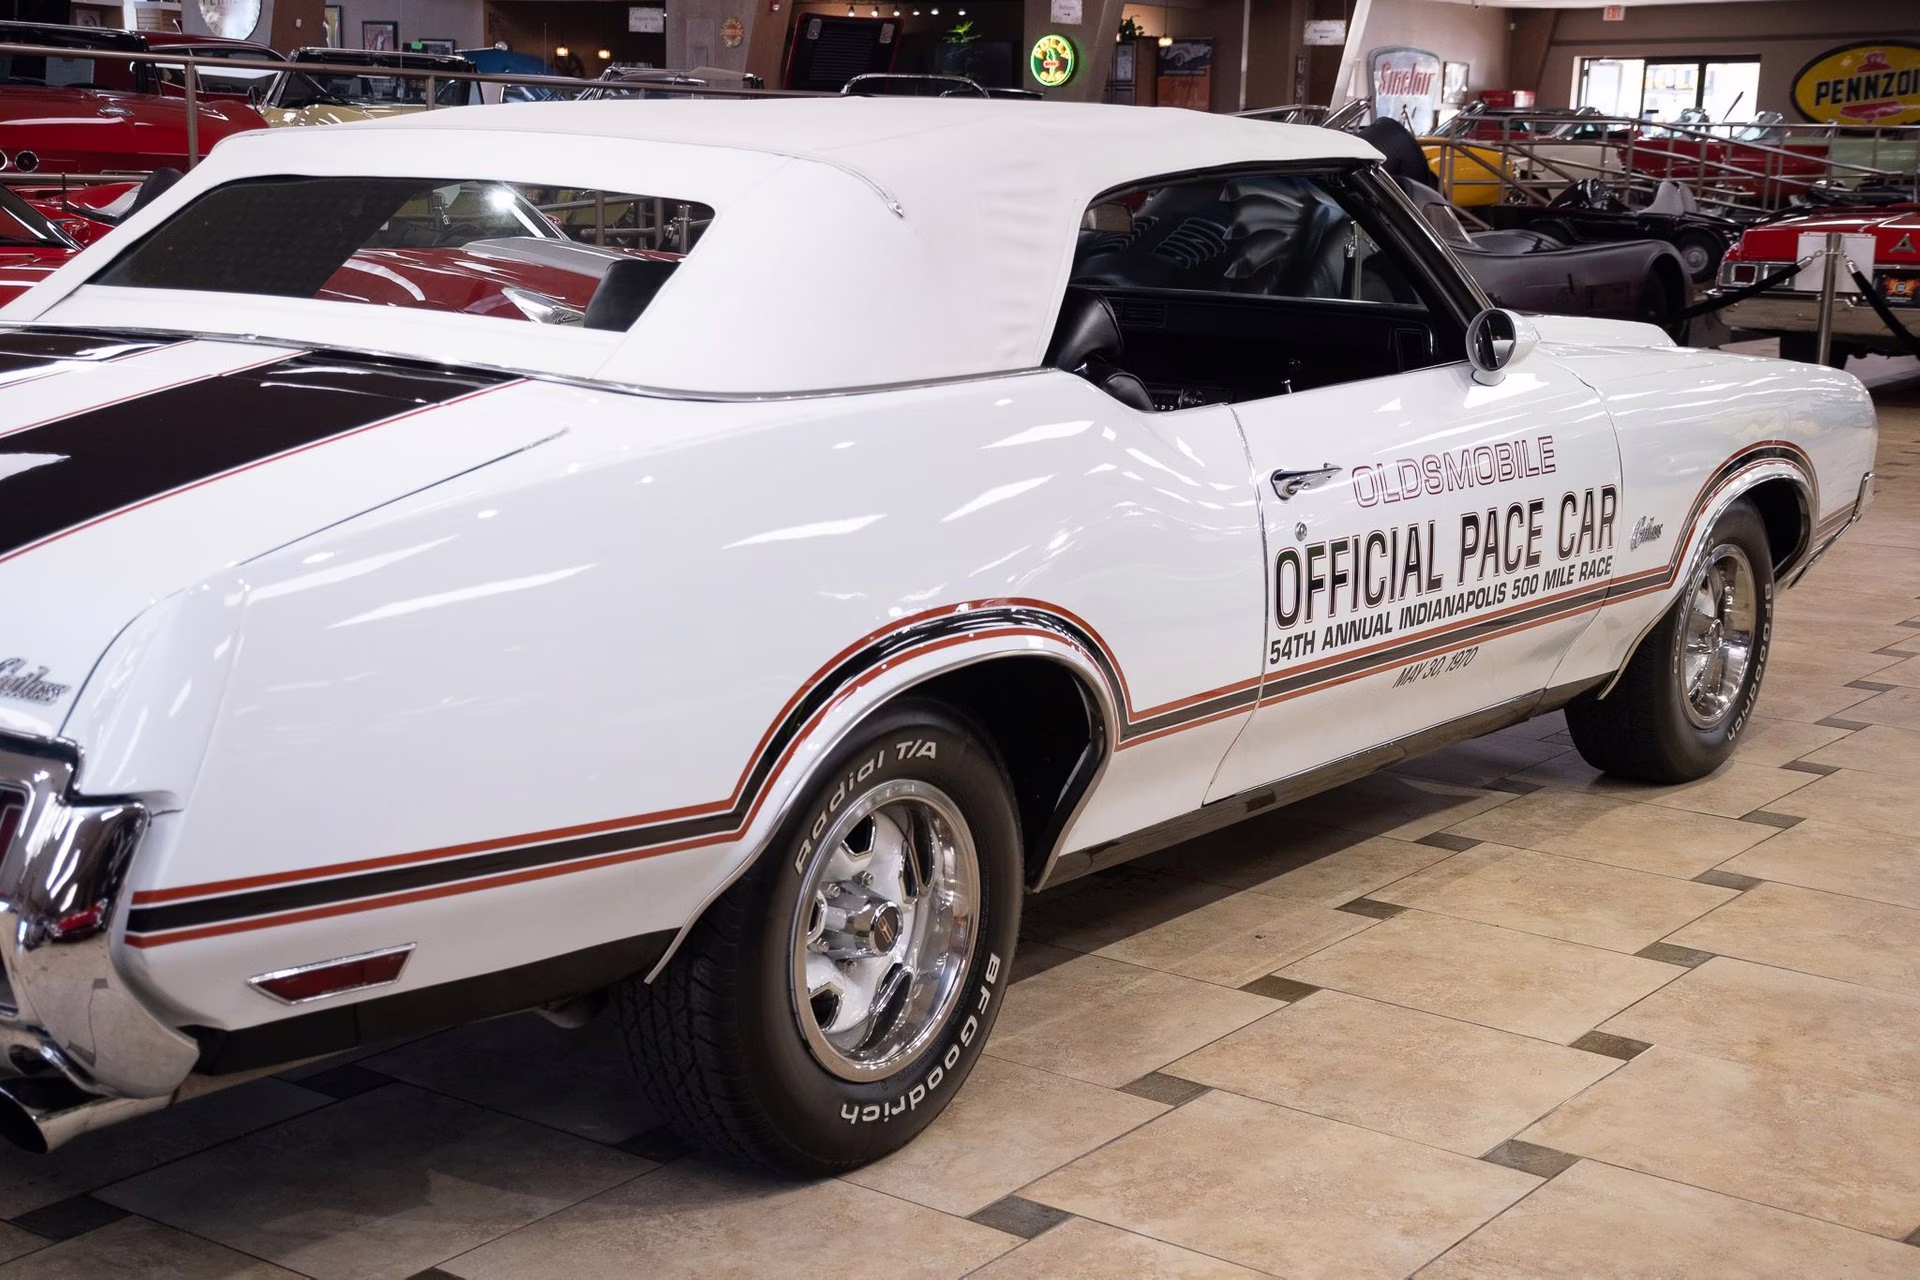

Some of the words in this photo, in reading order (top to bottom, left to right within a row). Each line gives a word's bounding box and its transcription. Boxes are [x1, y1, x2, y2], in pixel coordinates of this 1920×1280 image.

[1379, 61, 1435, 97] Sinclair
[1814, 68, 1920, 107] PENNZOI
[1352, 435, 1556, 508] OLDSMOBILE
[1274, 520, 1444, 630] OFFICIAL
[1457, 498, 1544, 586] PACE
[1557, 484, 1617, 561] CAR
[1270, 630, 1316, 665] 54TH
[1322, 611, 1393, 651] ANNUAL
[1399, 582, 1507, 630] INDIANAPOLIS
[1512, 573, 1539, 600] 500
[1543, 564, 1575, 591] MILE
[1579, 555, 1613, 582] RACE
[1392, 663, 1425, 688] MAY
[1422, 656, 1447, 680] 30,
[1445, 646, 1479, 672] 1970
[794, 750, 884, 876] Radial
[895, 739, 937, 760] T/A
[839, 952, 1000, 1125] BFGoodrich
